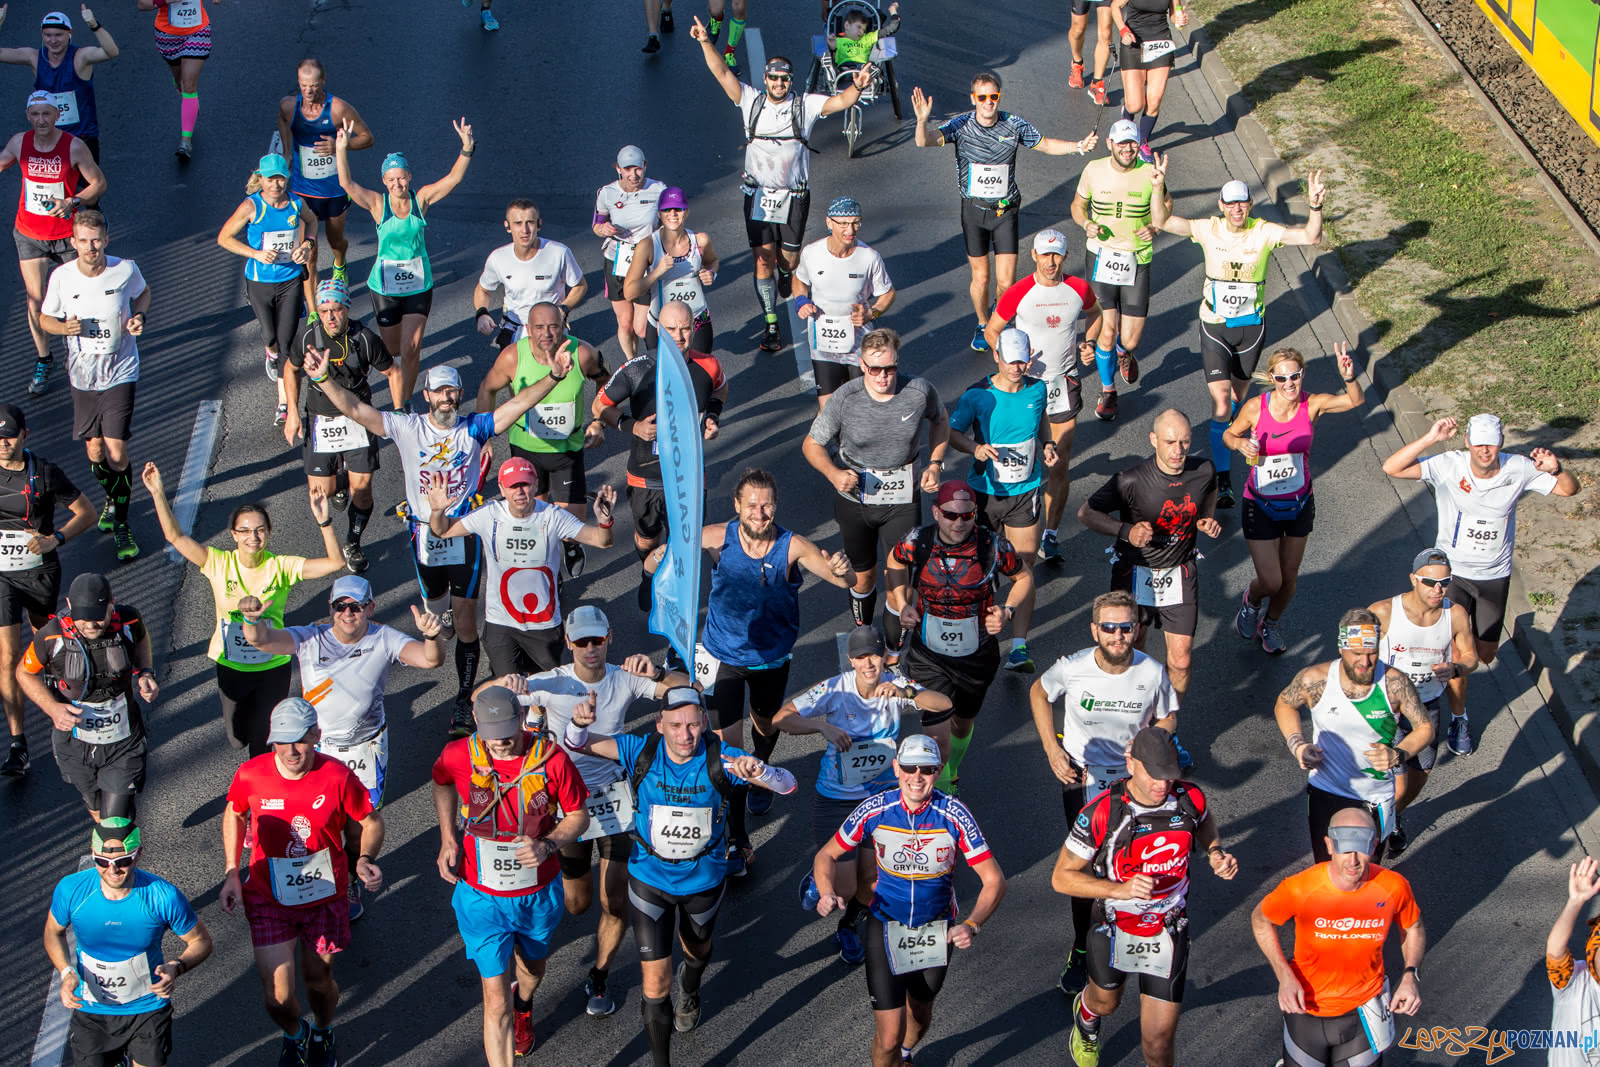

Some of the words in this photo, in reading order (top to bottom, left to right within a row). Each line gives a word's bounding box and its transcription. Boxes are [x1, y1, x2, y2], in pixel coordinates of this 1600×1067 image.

[177, 8, 197, 17] 4726
[1148, 41, 1170, 51] 2540
[28, 163, 62, 173] SZPIKU
[307, 157, 333, 167] 2880
[977, 176, 1003, 185] 4694
[761, 198, 782, 209] 2114
[272, 241, 294, 251] 2218
[1105, 260, 1130, 272] 4014
[394, 272, 414, 281] 656
[669, 291, 697, 302] 2669
[1222, 294, 1249, 305] 4017
[89, 329, 111, 339] 558
[821, 328, 847, 339] 2326
[538, 415, 566, 425] 4618
[321, 426, 348, 438] 3591
[1267, 467, 1294, 480] 1467
[874, 480, 905, 491] 4623
[1467, 528, 1498, 541] 3683
[428, 537, 454, 550] 3411
[506, 538, 537, 551] 5159
[1, 545, 30, 555] 3797
[1145, 576, 1173, 589] 4599
[235, 635, 253, 647] 52
[941, 631, 964, 642] 691
[695, 662, 709, 675] 96
[1408, 672, 1432, 684] 533
[86, 712, 121, 729] 5030
[851, 754, 886, 768] 2799
[588, 799, 621, 817] 3357
[946, 800, 978, 842] Szczecin
[660, 825, 701, 840] 4428
[493, 859, 522, 871] 855
[286, 868, 322, 886] 2656
[898, 935, 936, 950] 4545
[1126, 942, 1161, 955] 2613
[95, 974, 127, 989] 1242
